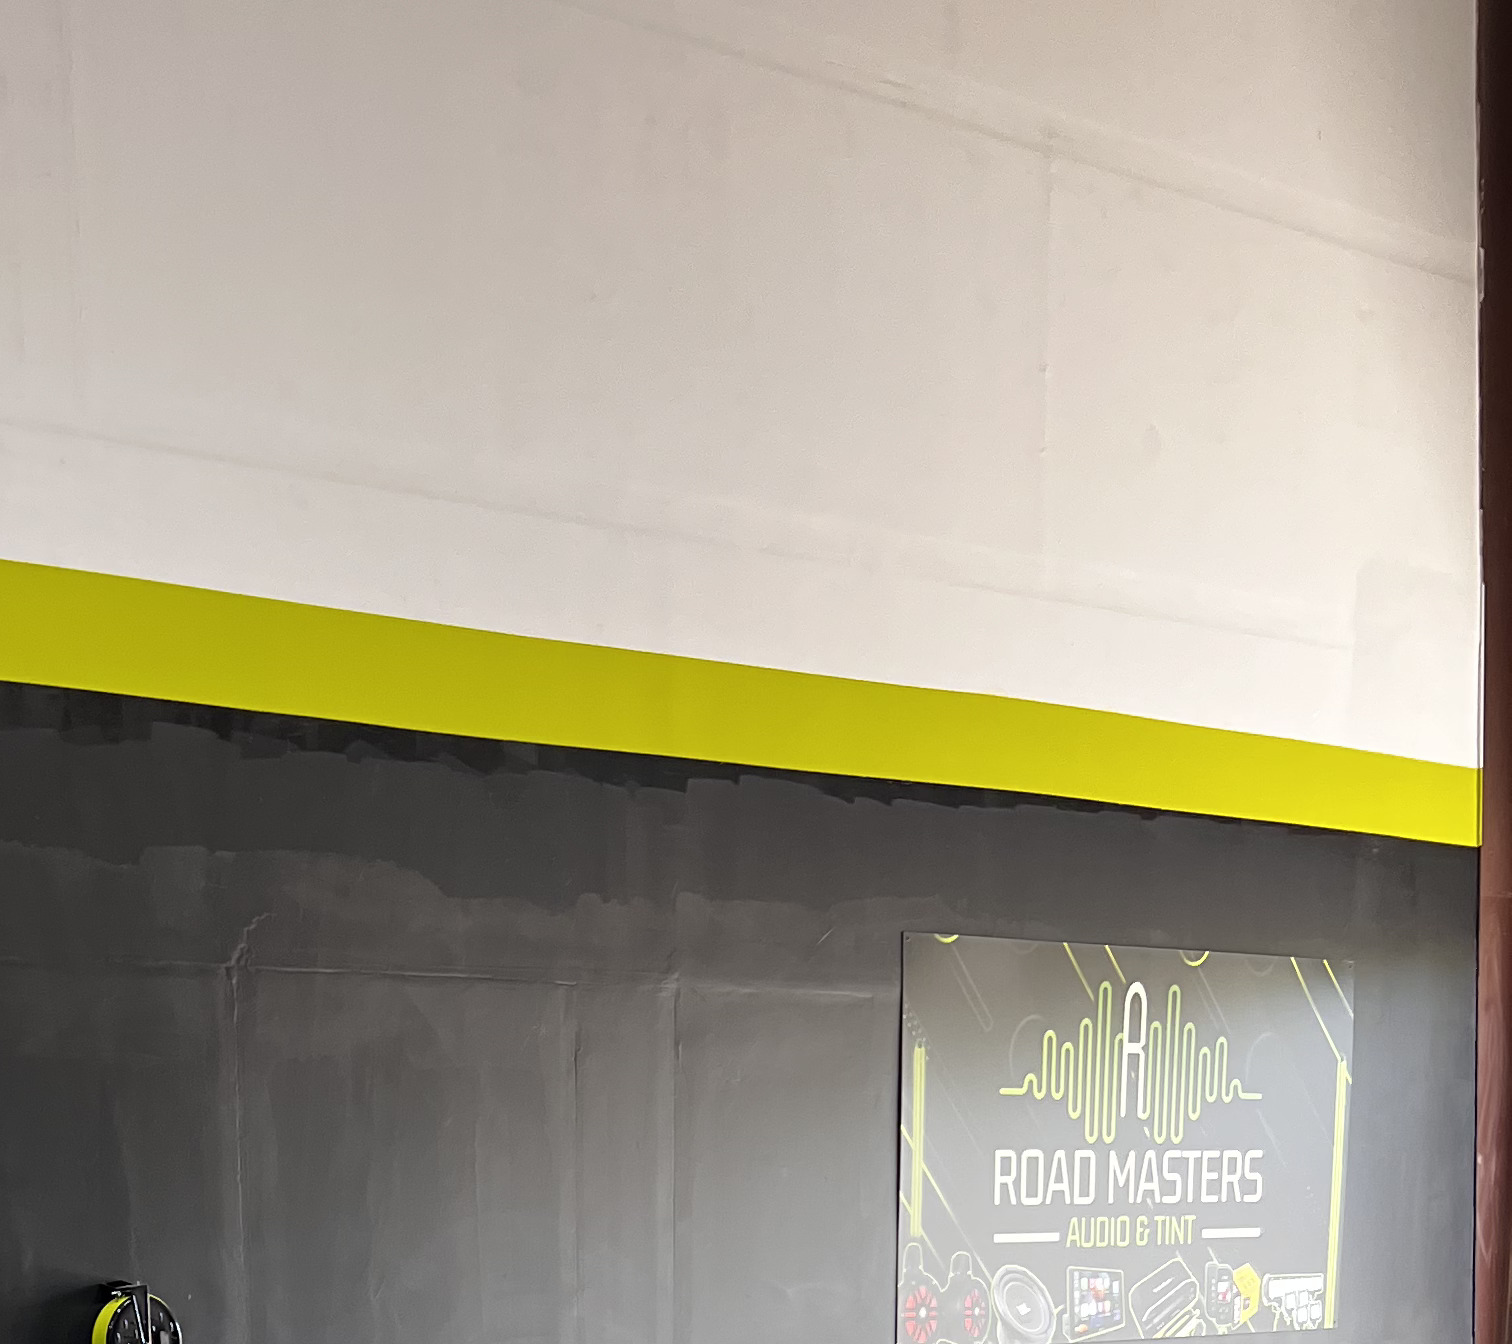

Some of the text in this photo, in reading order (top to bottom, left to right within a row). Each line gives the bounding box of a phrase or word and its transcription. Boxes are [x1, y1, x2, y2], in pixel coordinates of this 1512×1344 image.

[993, 1149, 1264, 1205] ROAD MASTERS
[1065, 1214, 1197, 1248] AUDIO & TINT
